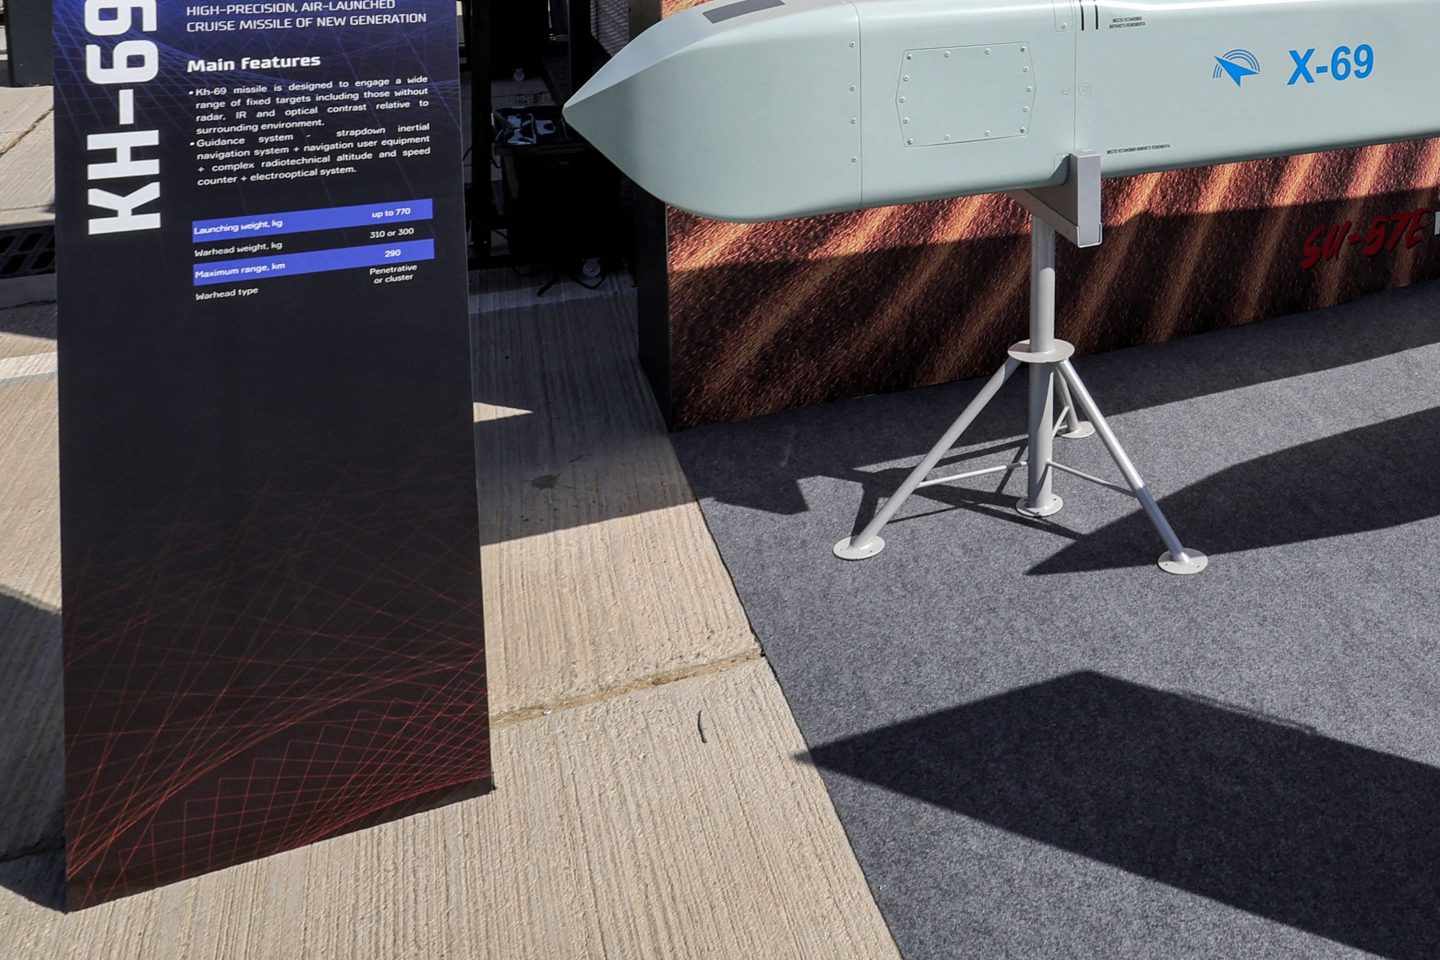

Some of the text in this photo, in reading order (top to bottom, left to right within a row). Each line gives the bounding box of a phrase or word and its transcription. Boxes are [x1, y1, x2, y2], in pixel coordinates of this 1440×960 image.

[300, 0, 395, 11] AIR-LAUNCHED
[186, 13, 426, 32] CRUISE MISSILE OF NEW GENERATION
[187, 56, 320, 72] Main Features
[1287, 43, 1374, 85] X-69
[195, 86, 226, 95] Kh-69
[233, 84, 267, 93] missile
[288, 80, 332, 91] designed
[354, 79, 389, 87] engage
[407, 75, 427, 83] wide
[195, 87, 427, 109] range of fixed targets including those without
[235, 110, 246, 118] IR
[256, 109, 275, 117] and
[284, 106, 317, 116] optical
[326, 104, 366, 112] contrast
[375, 100, 410, 109] relative
[196, 123, 258, 134] surrounding
[196, 122, 429, 147] Guidance system strapdown inertial
[196, 149, 250, 160] navigation
[253, 147, 289, 156] system
[303, 141, 353, 151] navigation
[380, 135, 429, 146] equipment
[211, 146, 430, 171] complex radiotechnical altitude and speed
[197, 176, 237, 185] counter
[250, 168, 317, 181] electrooptical
[395, 207, 410, 215] 770
[193, 224, 239, 234] Launching
[271, 219, 282, 227] kg
[369, 230, 385, 238] 310
[397, 227, 414, 235] 300
[194, 246, 234, 256] Warhead
[384, 249, 401, 257] 290
[195, 268, 239, 278] Maximum
[369, 264, 417, 274] Penetrative
[384, 274, 413, 282] cluster
[195, 288, 258, 300] Warhead type
